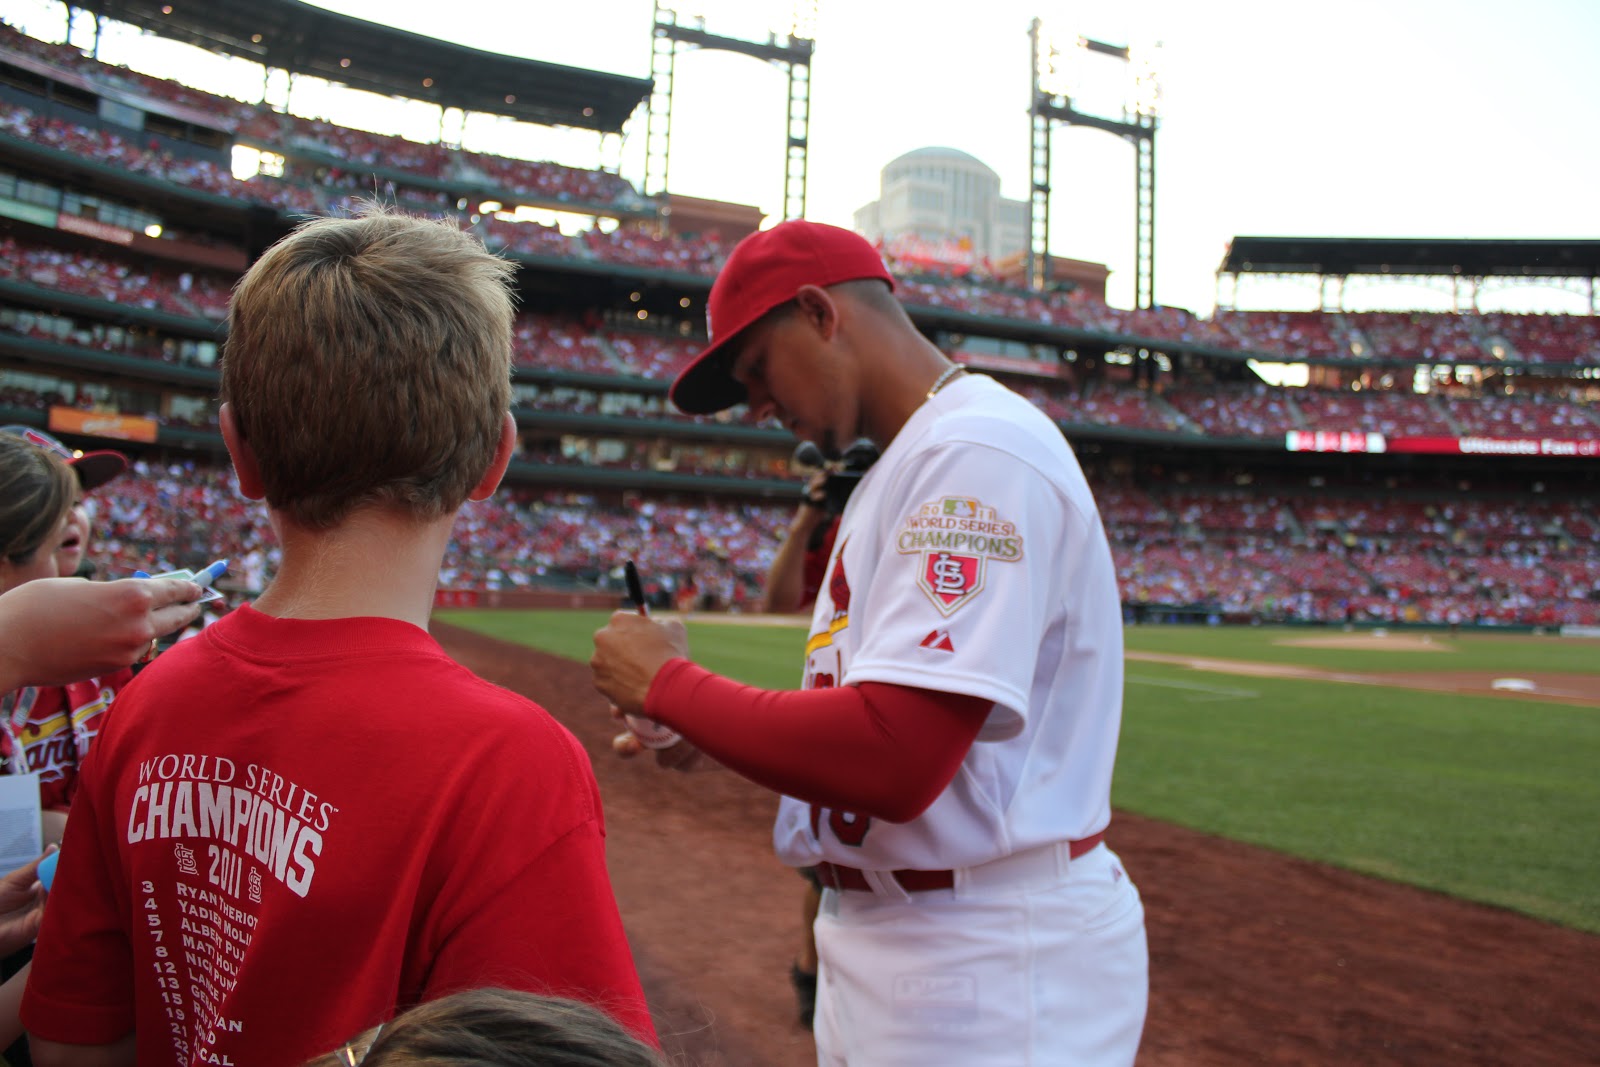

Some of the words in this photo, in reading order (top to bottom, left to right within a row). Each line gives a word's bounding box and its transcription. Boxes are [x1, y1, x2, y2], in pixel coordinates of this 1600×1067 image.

[909, 517, 956, 529] WORLD
[959, 520, 1010, 536] SERIES
[899, 531, 1018, 557] CHAMPIONS
[139, 754, 236, 784] WORLD
[245, 763, 335, 831] SERIES
[127, 781, 323, 898] CHAMPIONS
[208, 844, 243, 899] 2011
[142, 881, 155, 893] 3
[176, 882, 218, 906] RYAN
[144, 897, 158, 910] 4
[147, 914, 161, 926] 5
[150, 930, 164, 942] 7
[155, 946, 169, 958] 8
[153, 961, 177, 974] 12
[158, 976, 180, 990] 13
[162, 992, 183, 1005] 15
[166, 1007, 185, 1020] 19
[171, 1022, 188, 1037] 21
[173, 1037, 189, 1054] 22
